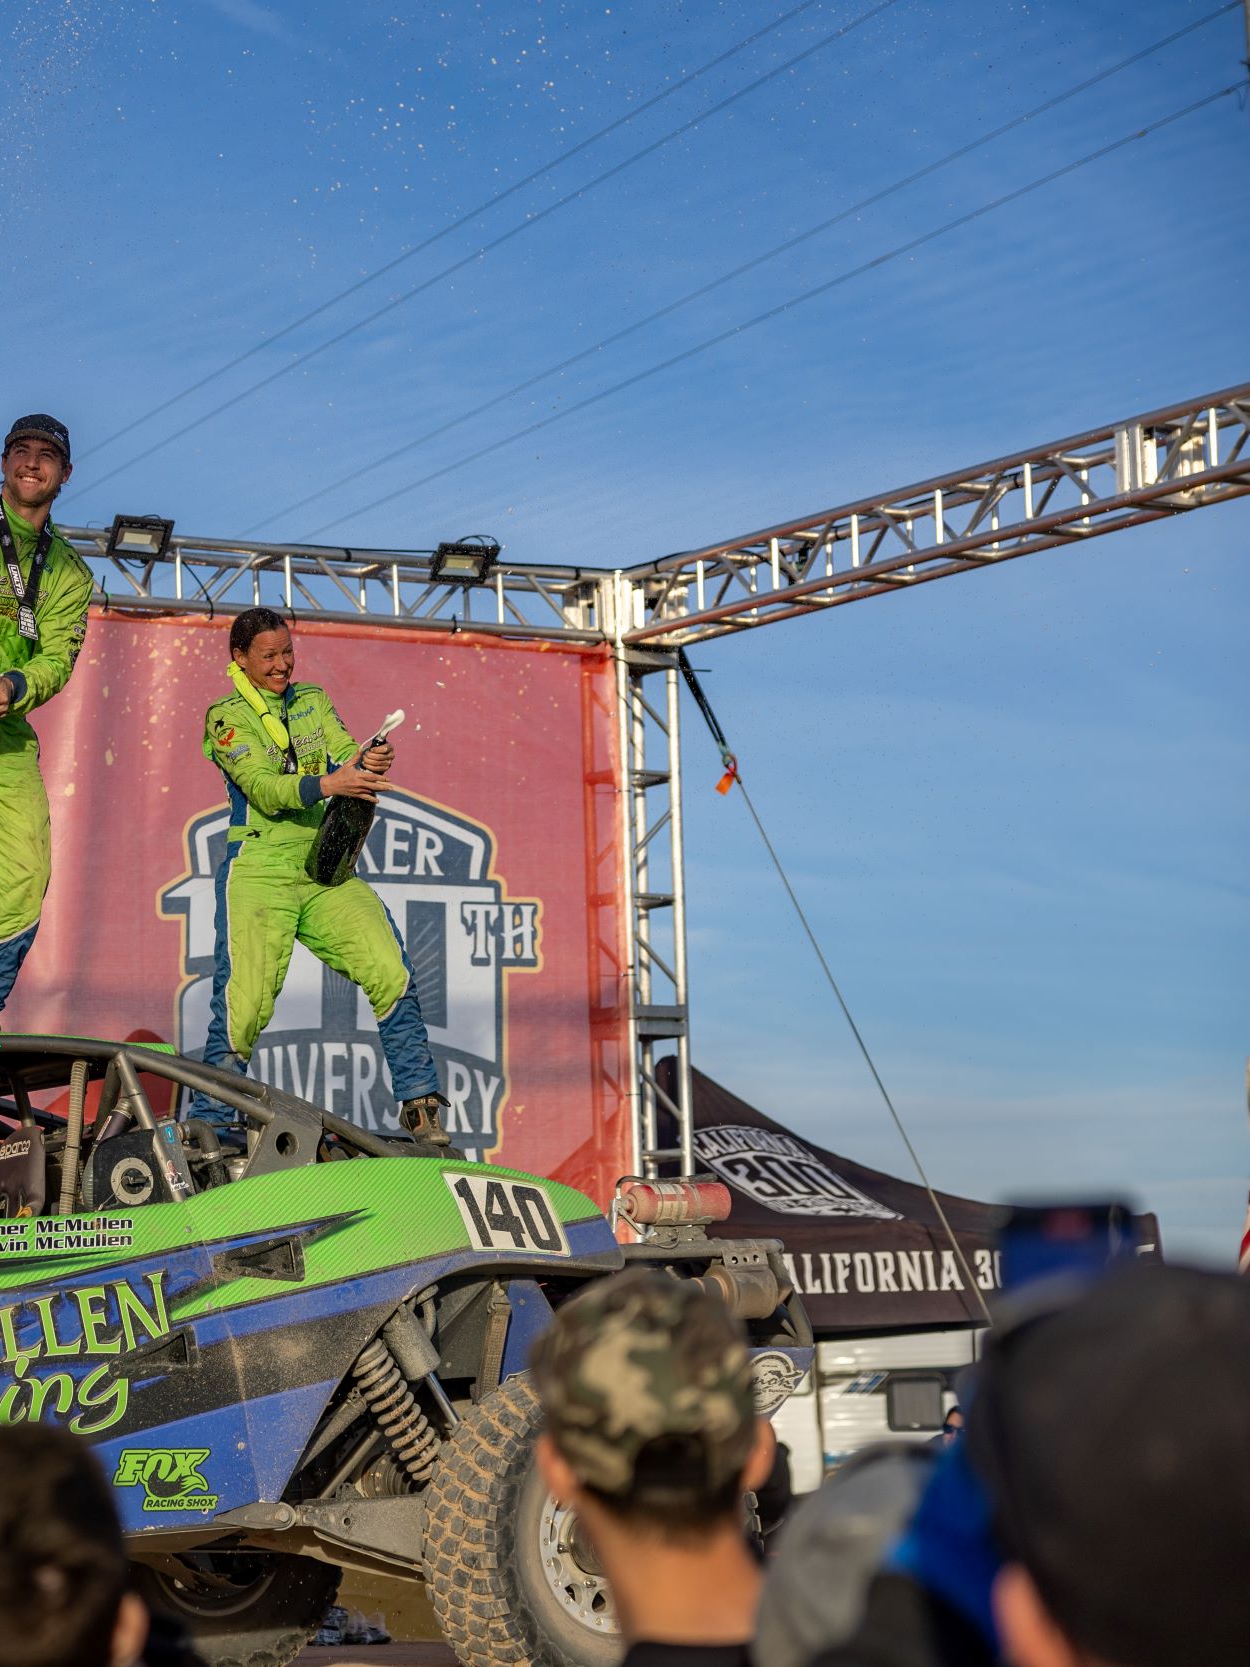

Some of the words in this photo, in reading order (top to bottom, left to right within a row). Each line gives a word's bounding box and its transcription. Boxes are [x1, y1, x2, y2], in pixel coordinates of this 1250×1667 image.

[461, 902, 537, 960] TH
[0, 1139, 31, 1156] sparco
[722, 1154, 861, 1201] 300
[34, 1216, 134, 1234] McMullen
[454, 1177, 563, 1252] 140
[33, 1232, 133, 1251] McMullen
[782, 1250, 966, 1295] ALIFORNIA
[118, 1450, 207, 1486] FOX
[146, 1497, 185, 1509] RACING
[186, 1496, 217, 1508] SHOX
